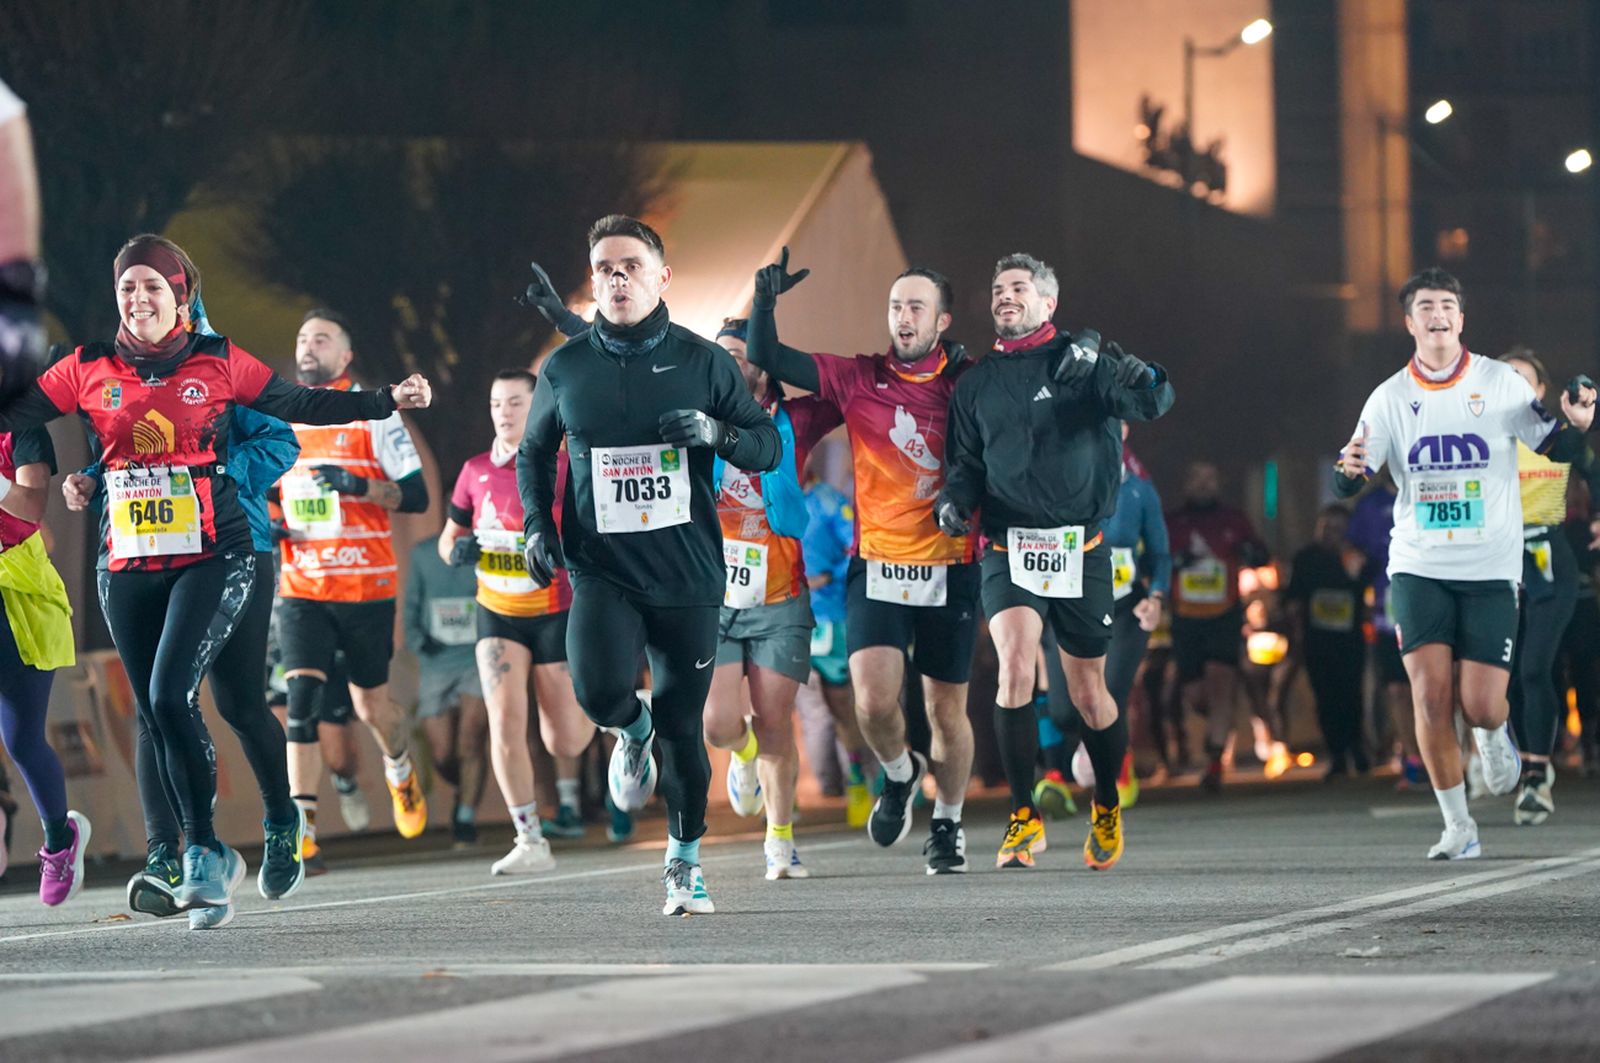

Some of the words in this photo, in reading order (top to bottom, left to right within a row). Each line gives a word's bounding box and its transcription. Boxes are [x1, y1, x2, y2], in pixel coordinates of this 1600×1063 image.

[904, 439, 925, 459] 43
[612, 456, 639, 466] NOCHE
[641, 455, 652, 464] DE
[603, 467, 620, 477] SAN
[123, 479, 149, 488] NOCHE
[150, 477, 161, 486] DE
[611, 475, 672, 503] 7033
[730, 480, 749, 499] 43
[129, 499, 174, 527] 646
[1427, 501, 1472, 523] 7851
[724, 565, 750, 586] 79
[882, 562, 932, 582] 6680
